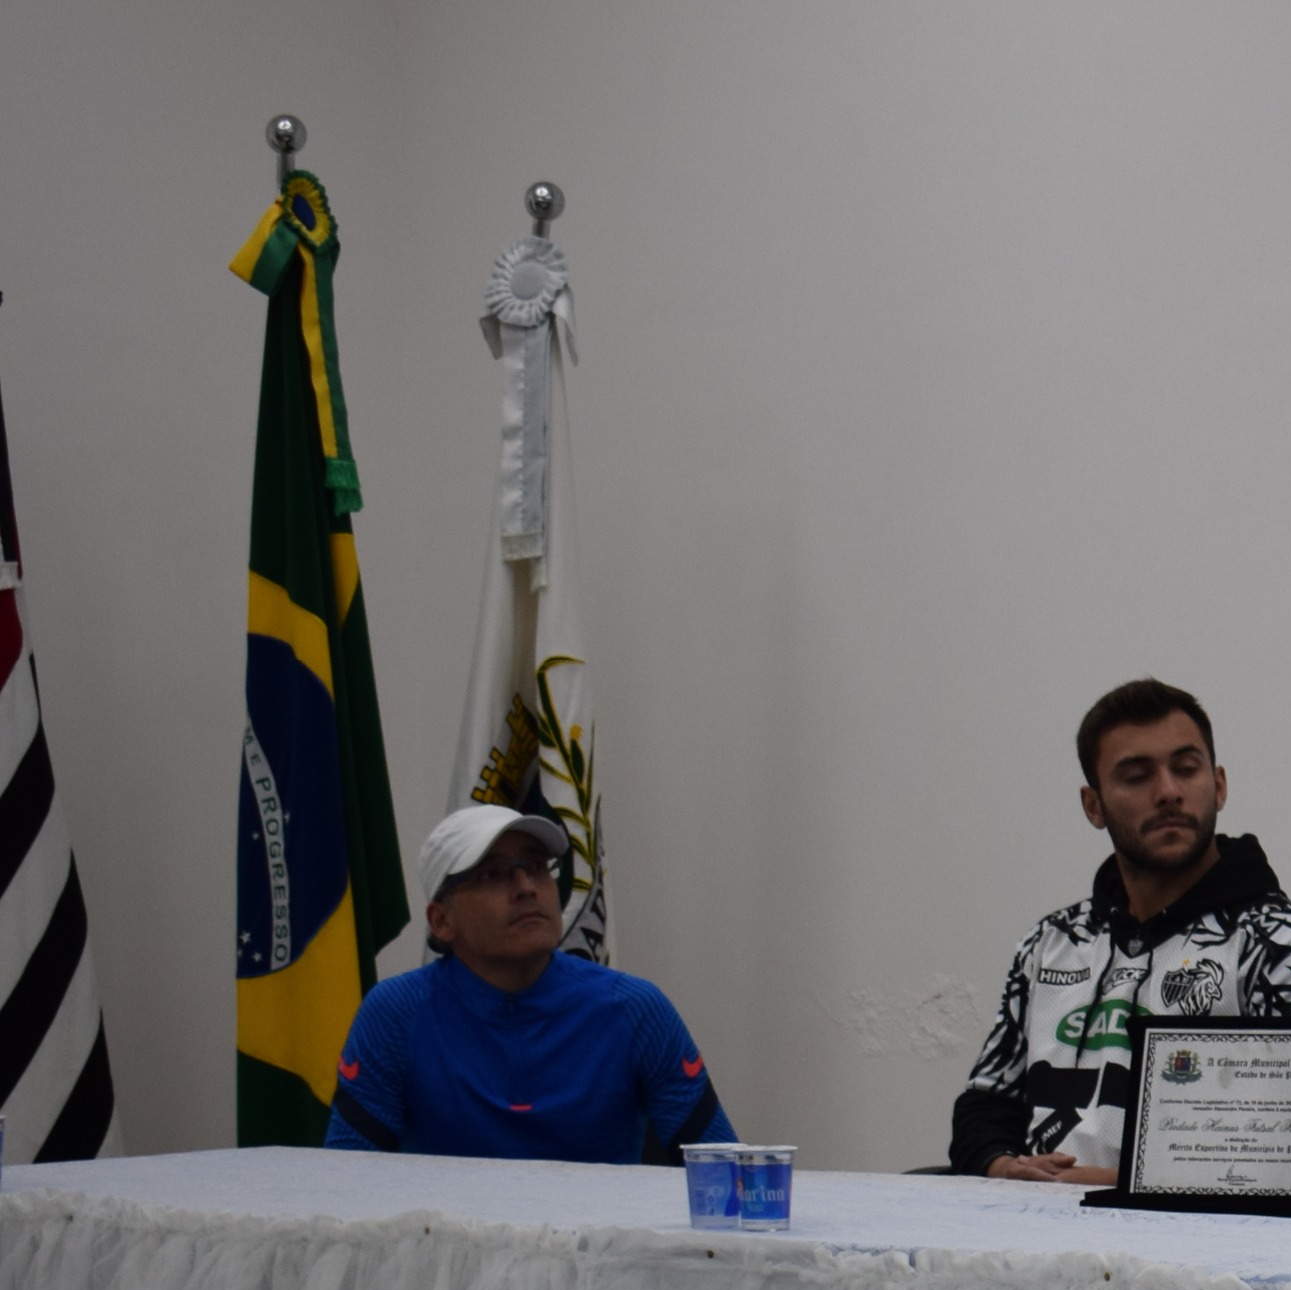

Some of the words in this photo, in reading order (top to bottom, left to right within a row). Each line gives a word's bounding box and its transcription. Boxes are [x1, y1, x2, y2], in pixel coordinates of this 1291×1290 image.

[250, 754, 262, 767] E
[255, 777, 289, 962] PROGRESSO
[1039, 968, 1090, 985] HINOVA
[1064, 1007, 1131, 1039] SAD
[1207, 1057, 1214, 1067] A
[1217, 1056, 1248, 1067] Câmara
[1250, 1057, 1291, 1069] Municipal
[1234, 1070, 1258, 1079] Estado
[1268, 1071, 1283, 1079] São
[1158, 1116, 1199, 1132] Piedade
[1276, 1145, 1284, 1153] de
